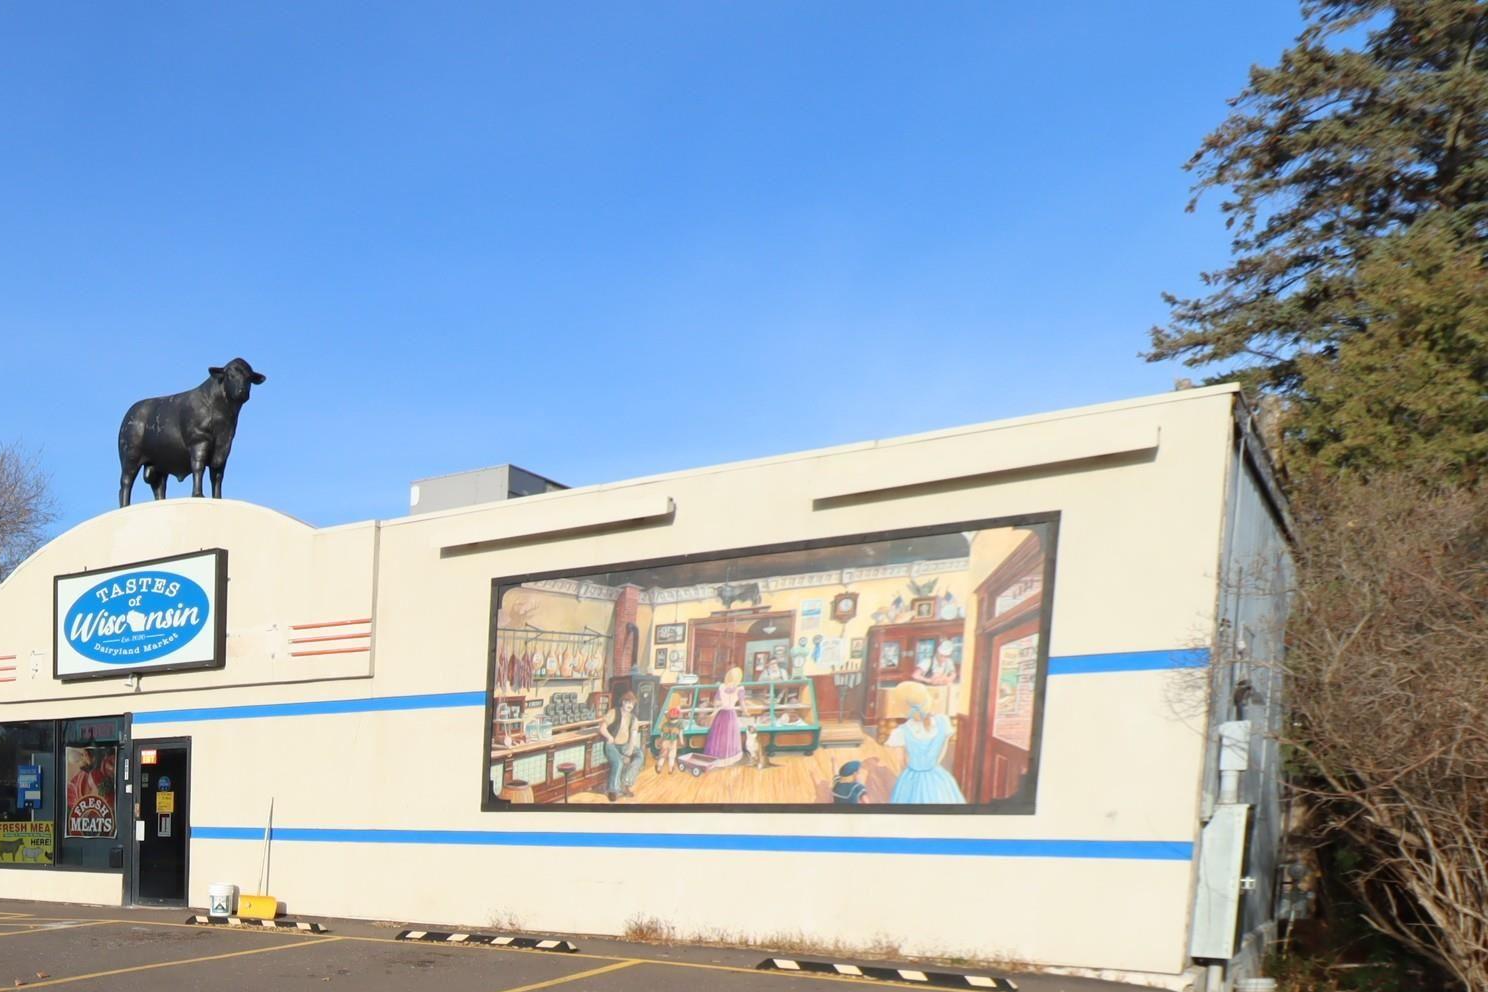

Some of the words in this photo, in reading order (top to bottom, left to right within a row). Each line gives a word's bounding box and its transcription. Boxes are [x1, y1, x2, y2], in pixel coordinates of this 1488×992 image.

[96, 577, 181, 603] TASTES
[128, 595, 142, 607] of
[70, 602, 200, 643] Wisconsin
[93, 642, 140, 656] Dairyland
[143, 632, 179, 652] Market
[73, 797, 109, 817] FRESH
[30, 823, 53, 833] MEA
[70, 817, 113, 834] MEATS
